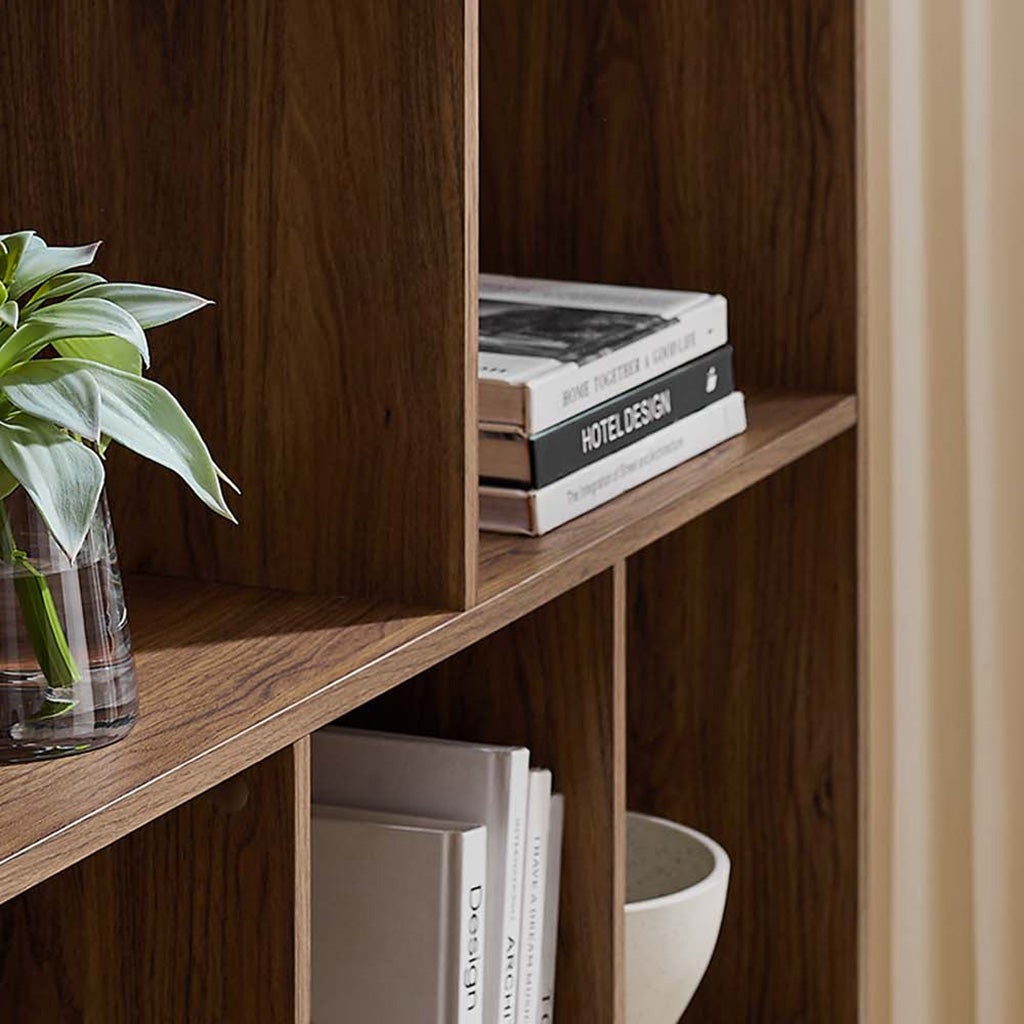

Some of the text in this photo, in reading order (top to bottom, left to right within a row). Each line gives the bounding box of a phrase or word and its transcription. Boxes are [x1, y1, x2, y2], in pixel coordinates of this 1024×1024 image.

[593, 357, 640, 392] TOGETHER
[531, 845, 541, 889] HAVE
[464, 885, 482, 1011] Design
[503, 936, 516, 1024] ARCHI
